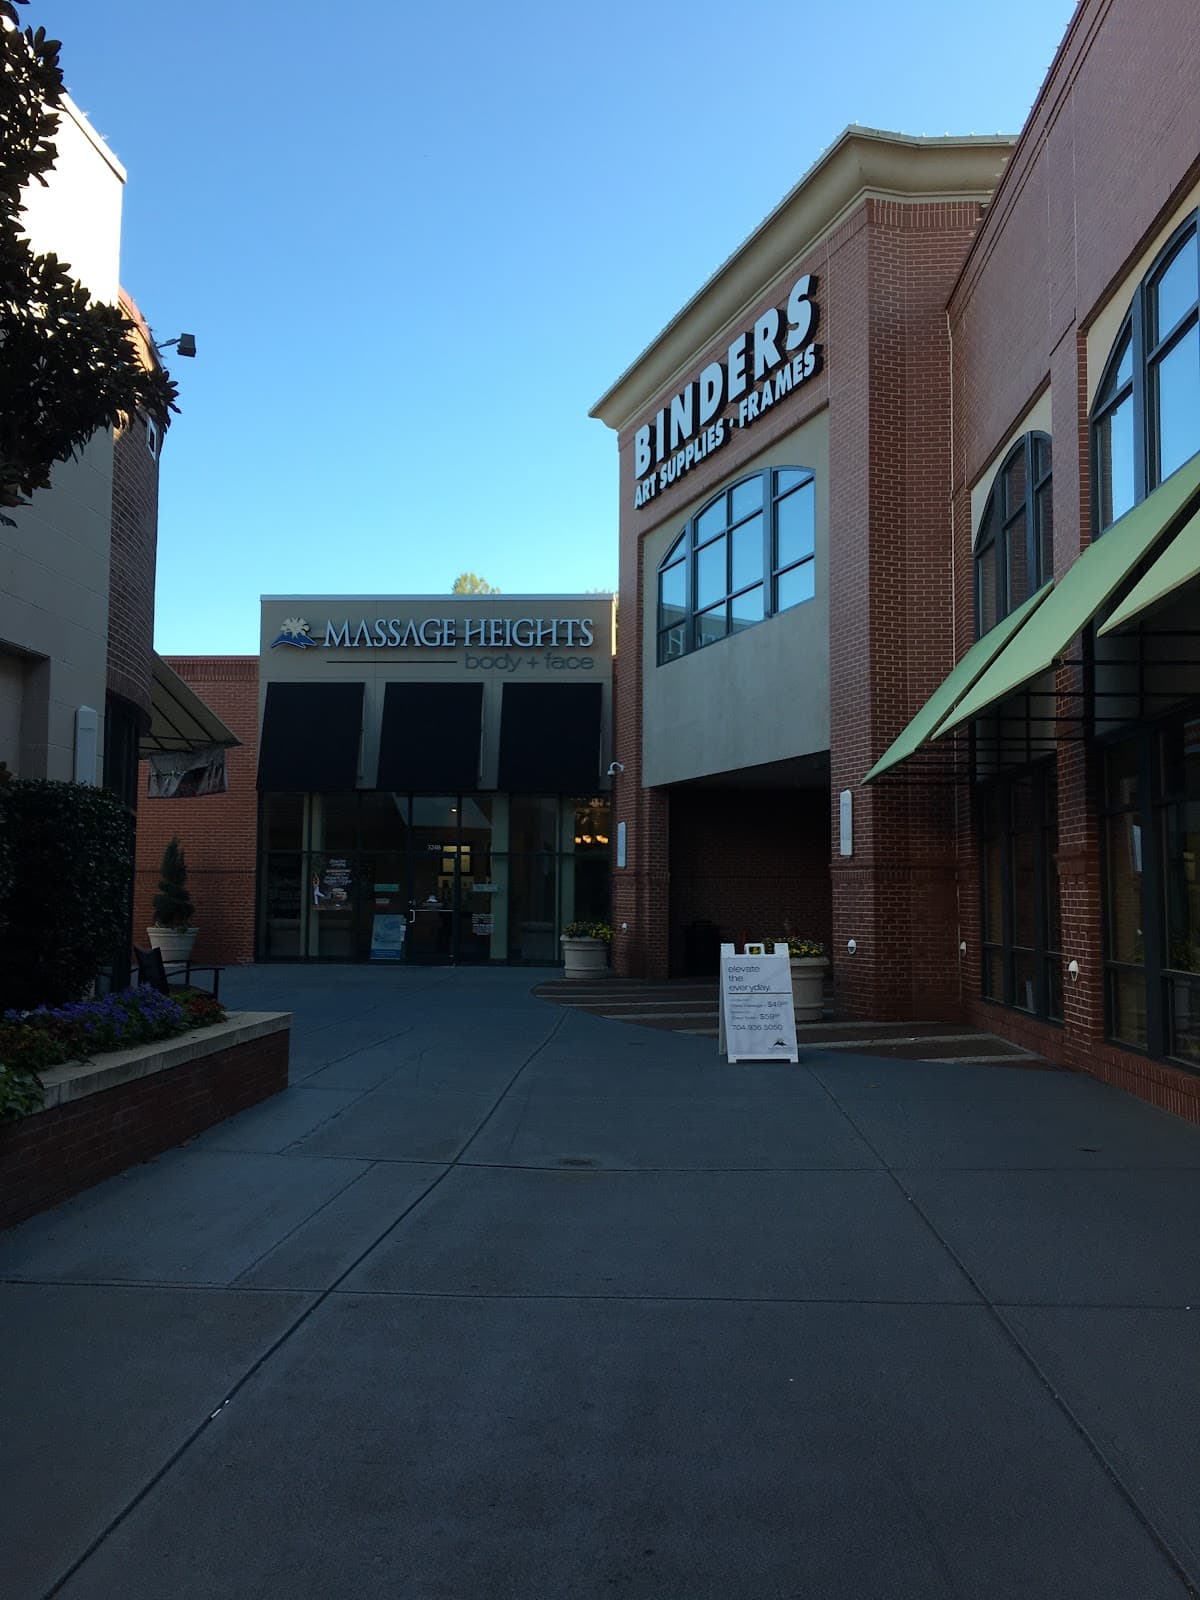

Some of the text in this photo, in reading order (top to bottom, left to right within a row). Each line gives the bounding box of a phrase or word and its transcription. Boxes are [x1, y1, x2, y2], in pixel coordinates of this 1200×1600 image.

[634, 273, 816, 481] BINDERS
[633, 343, 818, 511] ART SUPPLIES FRAMES
[322, 617, 594, 648] MASSAGE HEIGHTS
[464, 651, 522, 673] body
[543, 651, 595, 670] face
[727, 965, 760, 973] elevate
